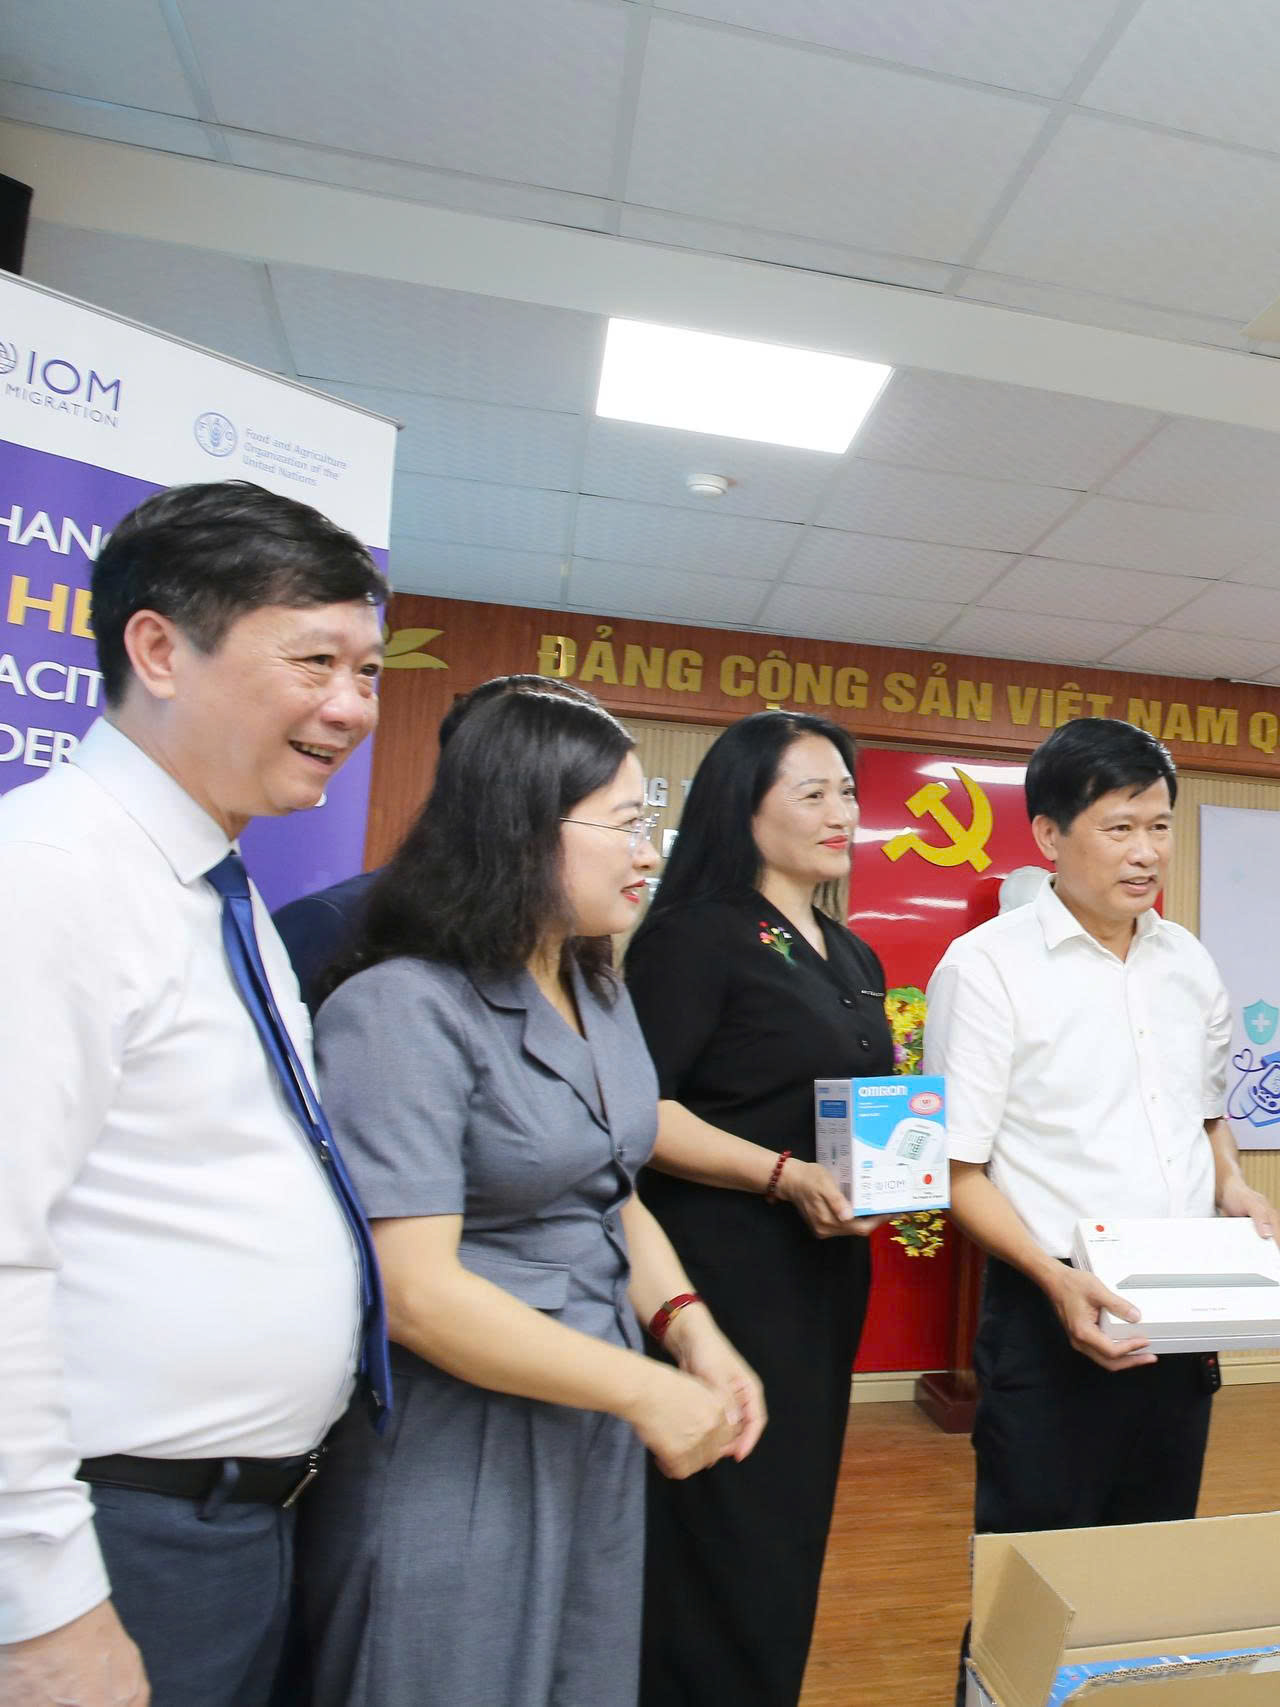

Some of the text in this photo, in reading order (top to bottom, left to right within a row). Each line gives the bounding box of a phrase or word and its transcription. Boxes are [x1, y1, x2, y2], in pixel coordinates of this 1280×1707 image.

[5, 382, 119, 429] MIGRATION
[27, 350, 121, 412] IOM
[242, 455, 317, 487] United Nations
[246, 428, 347, 470] Food and Agriculture
[0, 504, 112, 562] HAN
[537, 625, 704, 693] ĐẢNG
[720, 650, 870, 710] CỘNG
[882, 662, 993, 722] SẢN
[1127, 697, 1239, 746] NAM
